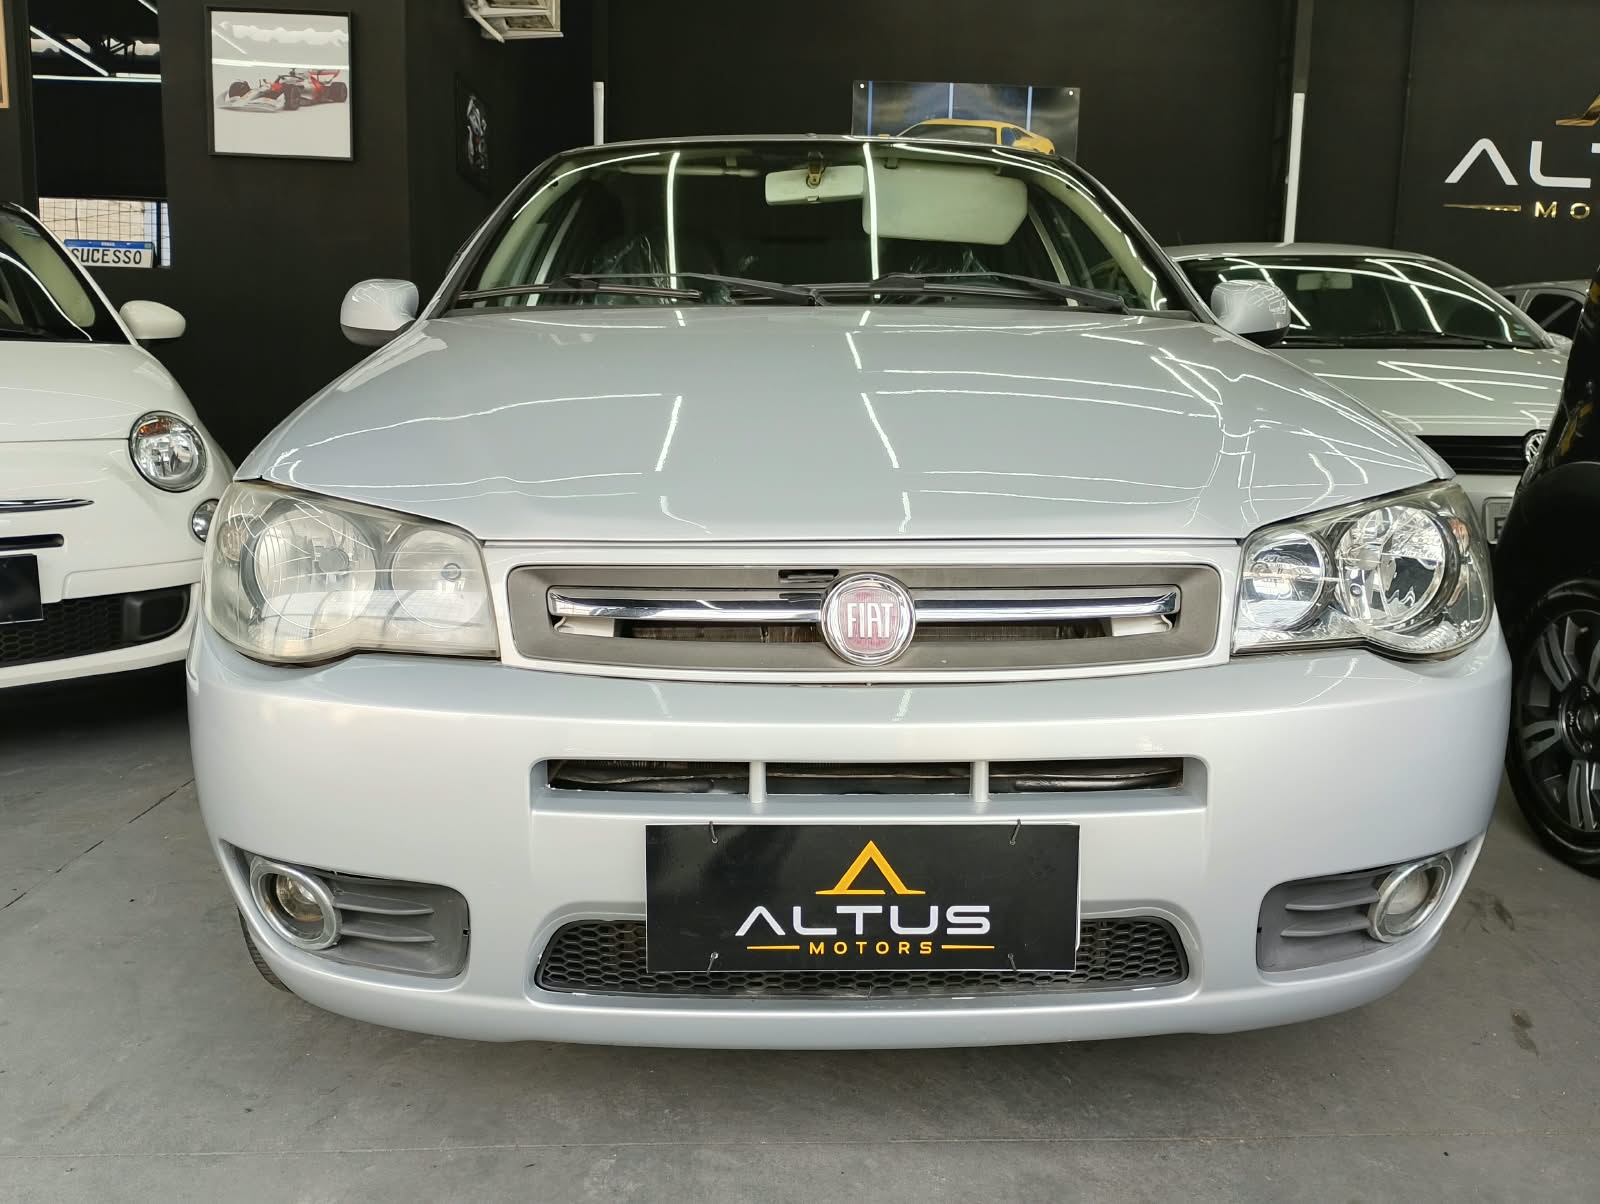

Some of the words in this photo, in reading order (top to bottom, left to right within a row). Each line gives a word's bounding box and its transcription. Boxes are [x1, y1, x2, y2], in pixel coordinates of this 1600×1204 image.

[1444, 138, 1600, 188] AL
[847, 602, 893, 638] FIAT
[734, 905, 991, 936] ALTUS
[809, 941, 933, 955] MOTORS
